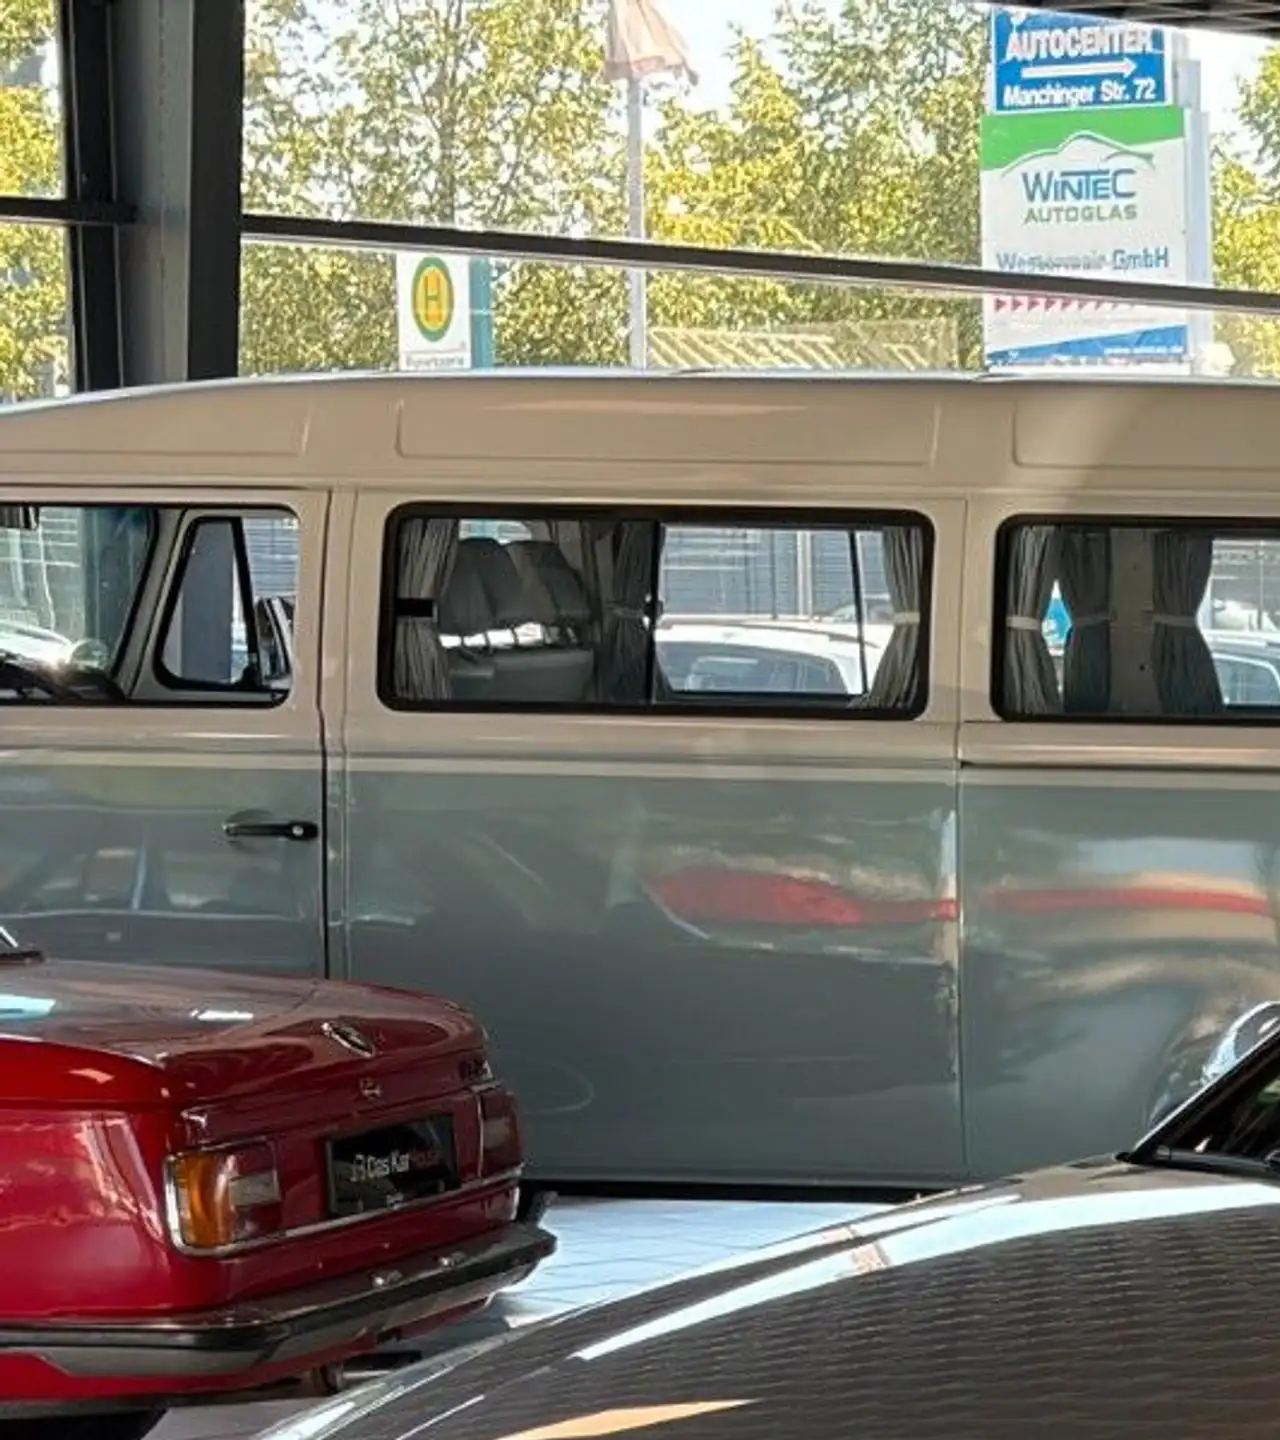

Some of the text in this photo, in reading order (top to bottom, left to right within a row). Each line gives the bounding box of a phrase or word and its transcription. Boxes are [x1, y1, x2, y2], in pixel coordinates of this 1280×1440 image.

[1006, 27, 1153, 61] AUTOCENTER
[1101, 79, 1130, 101] Str.
[1133, 77, 1157, 100] 72
[1023, 204, 1138, 225] AUTOGLAS
[1112, 247, 1169, 270] GmbH
[424, 275, 442, 322] H
